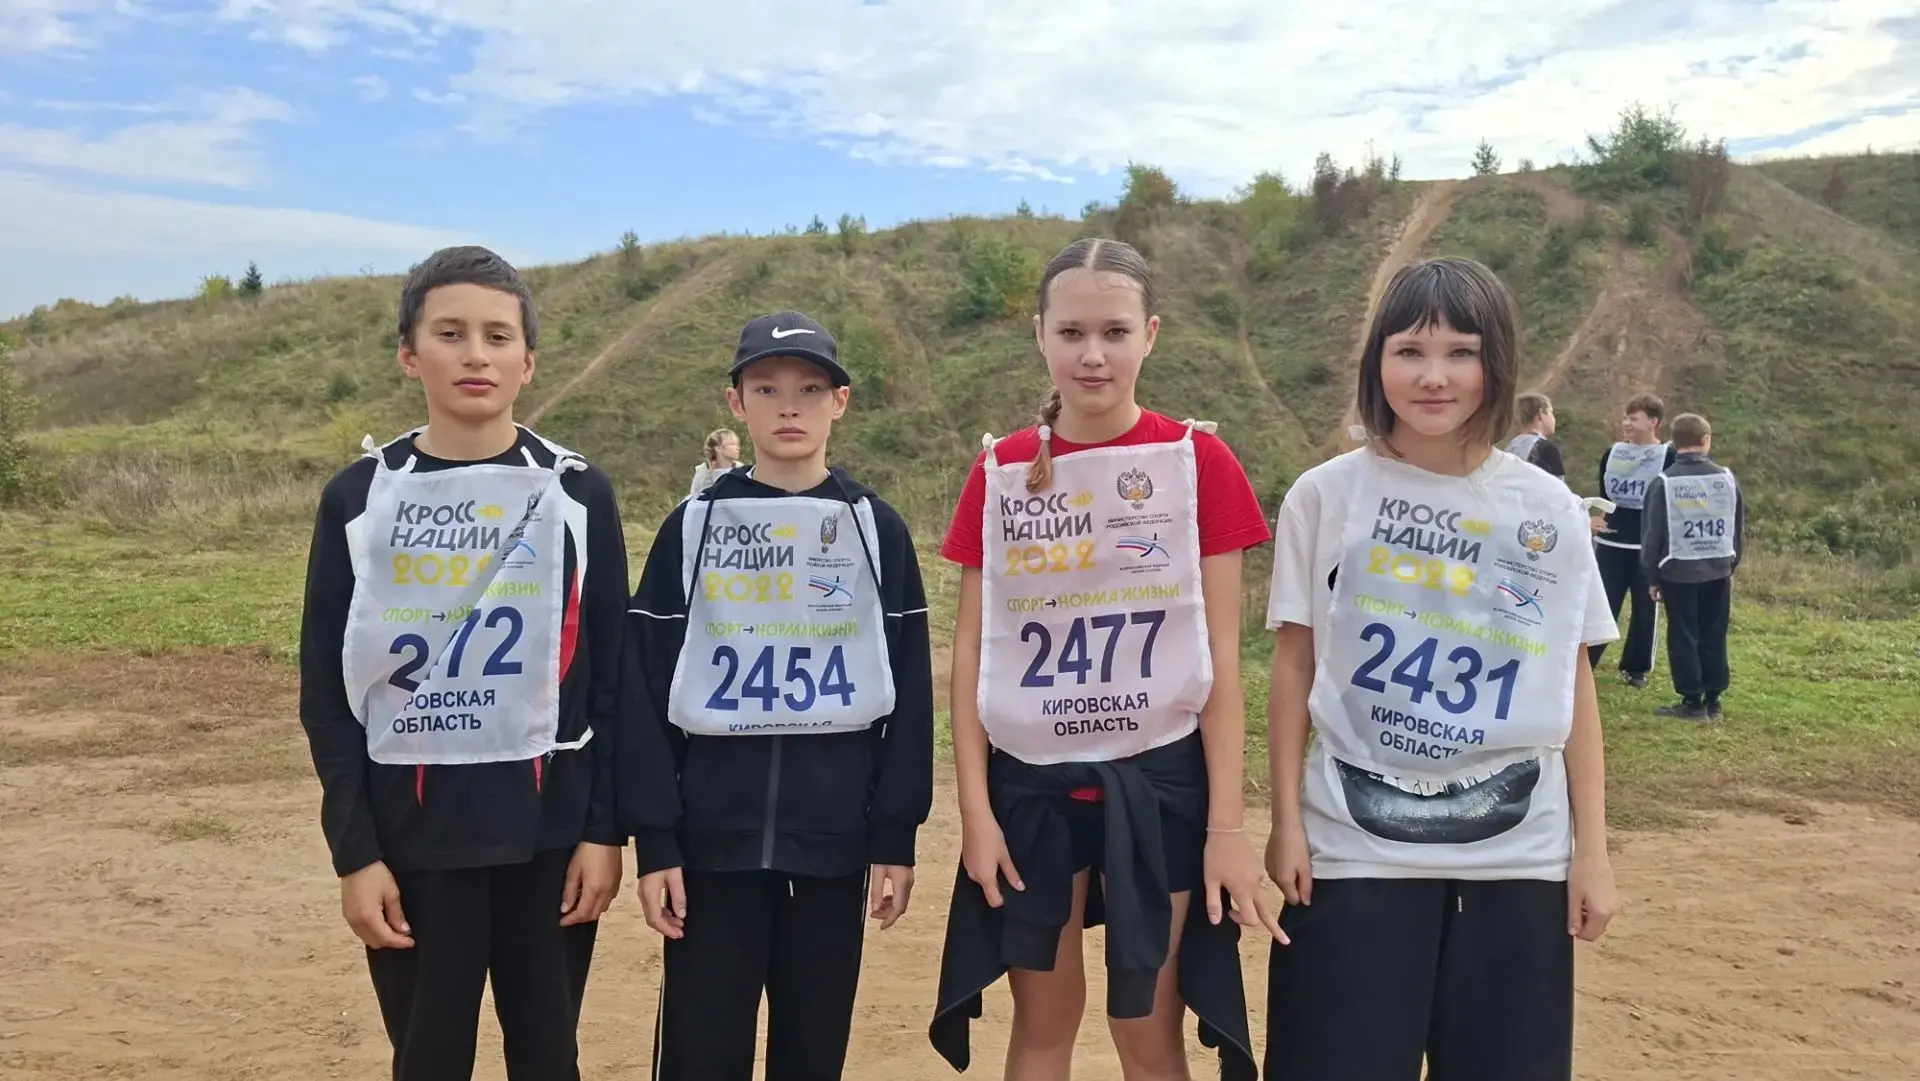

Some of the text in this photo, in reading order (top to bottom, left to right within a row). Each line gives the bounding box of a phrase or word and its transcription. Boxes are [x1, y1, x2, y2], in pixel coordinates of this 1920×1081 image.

[1611, 477, 1645, 497] 2411
[396, 500, 476, 526] КРОСС
[1000, 492, 1068, 517] КРОСС
[1378, 497, 1463, 534] КРОСС
[389, 526, 501, 551] НАЦИИ
[706, 522, 773, 546] КРОСС
[1003, 512, 1093, 541] НАЦИИ
[1371, 519, 1482, 563] НАЦИИ
[1683, 518, 1725, 539] 2118
[391, 553, 493, 587] 202
[703, 546, 794, 571] НАЦИИ
[1004, 540, 1096, 576] 2022
[1366, 546, 1476, 597] 2022
[704, 572, 795, 602] 2022
[1007, 583, 1180, 613] СПОРТ НОРМА ЖИЗНИ
[382, 608, 431, 624] СПОРТ
[1354, 594, 1405, 618] СПОРТ
[1417, 611, 1485, 640] НОРМА
[1487, 627, 1547, 657] ЖИЗНИ
[1020, 609, 1167, 688] 2477
[704, 645, 857, 712] 2454
[1350, 622, 1520, 721] 2431
[403, 689, 496, 711] РОВСКАЯ
[1042, 692, 1149, 717] КИРОВСКАЯ
[392, 713, 482, 734] ОБЛАСТЬ
[1054, 717, 1139, 737] ОБЛАСТЬ
[1371, 704, 1485, 746] КИРОВСКАЯ
